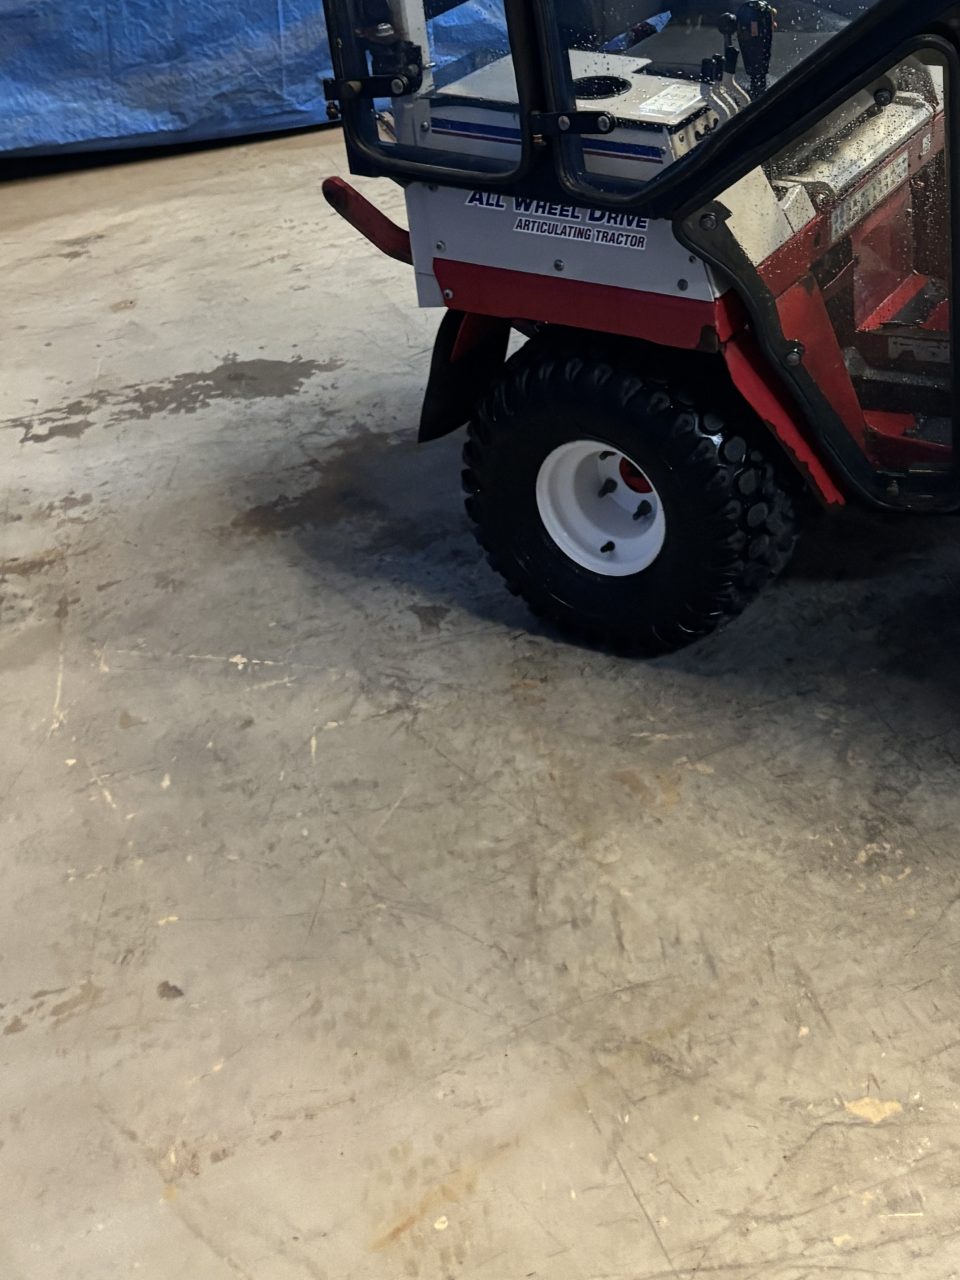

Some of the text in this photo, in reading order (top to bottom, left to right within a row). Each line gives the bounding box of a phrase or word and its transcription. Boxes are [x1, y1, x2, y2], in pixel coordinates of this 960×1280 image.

[467, 190, 647, 229] ALL WHEEL DRIVE
[515, 219, 646, 248] ARTICULATING TRACTOR
